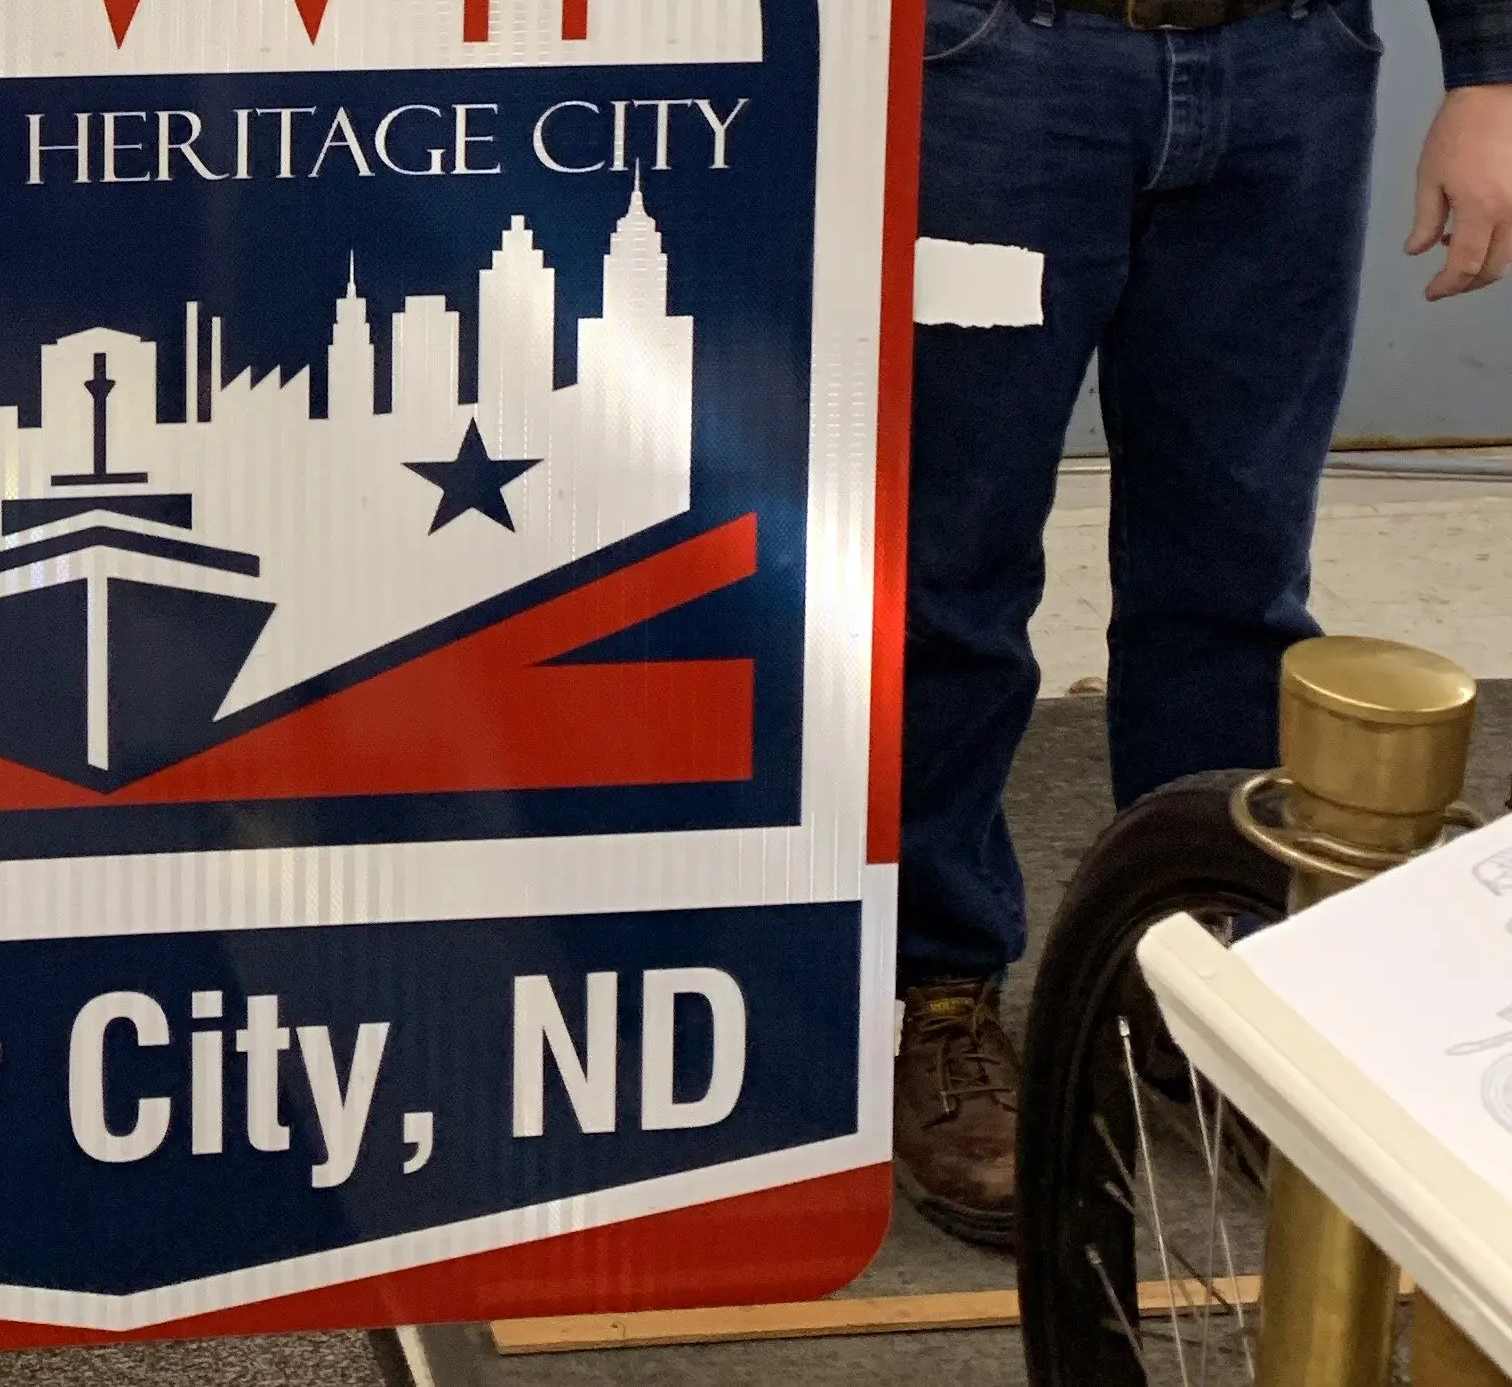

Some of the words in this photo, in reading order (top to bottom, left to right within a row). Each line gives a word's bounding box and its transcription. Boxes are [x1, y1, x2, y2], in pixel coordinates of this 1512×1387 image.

[24, 103, 501, 185] HERITAGE
[533, 98, 749, 173] CITY
[68, 990, 435, 1189] City,
[511, 966, 749, 1138] ND
